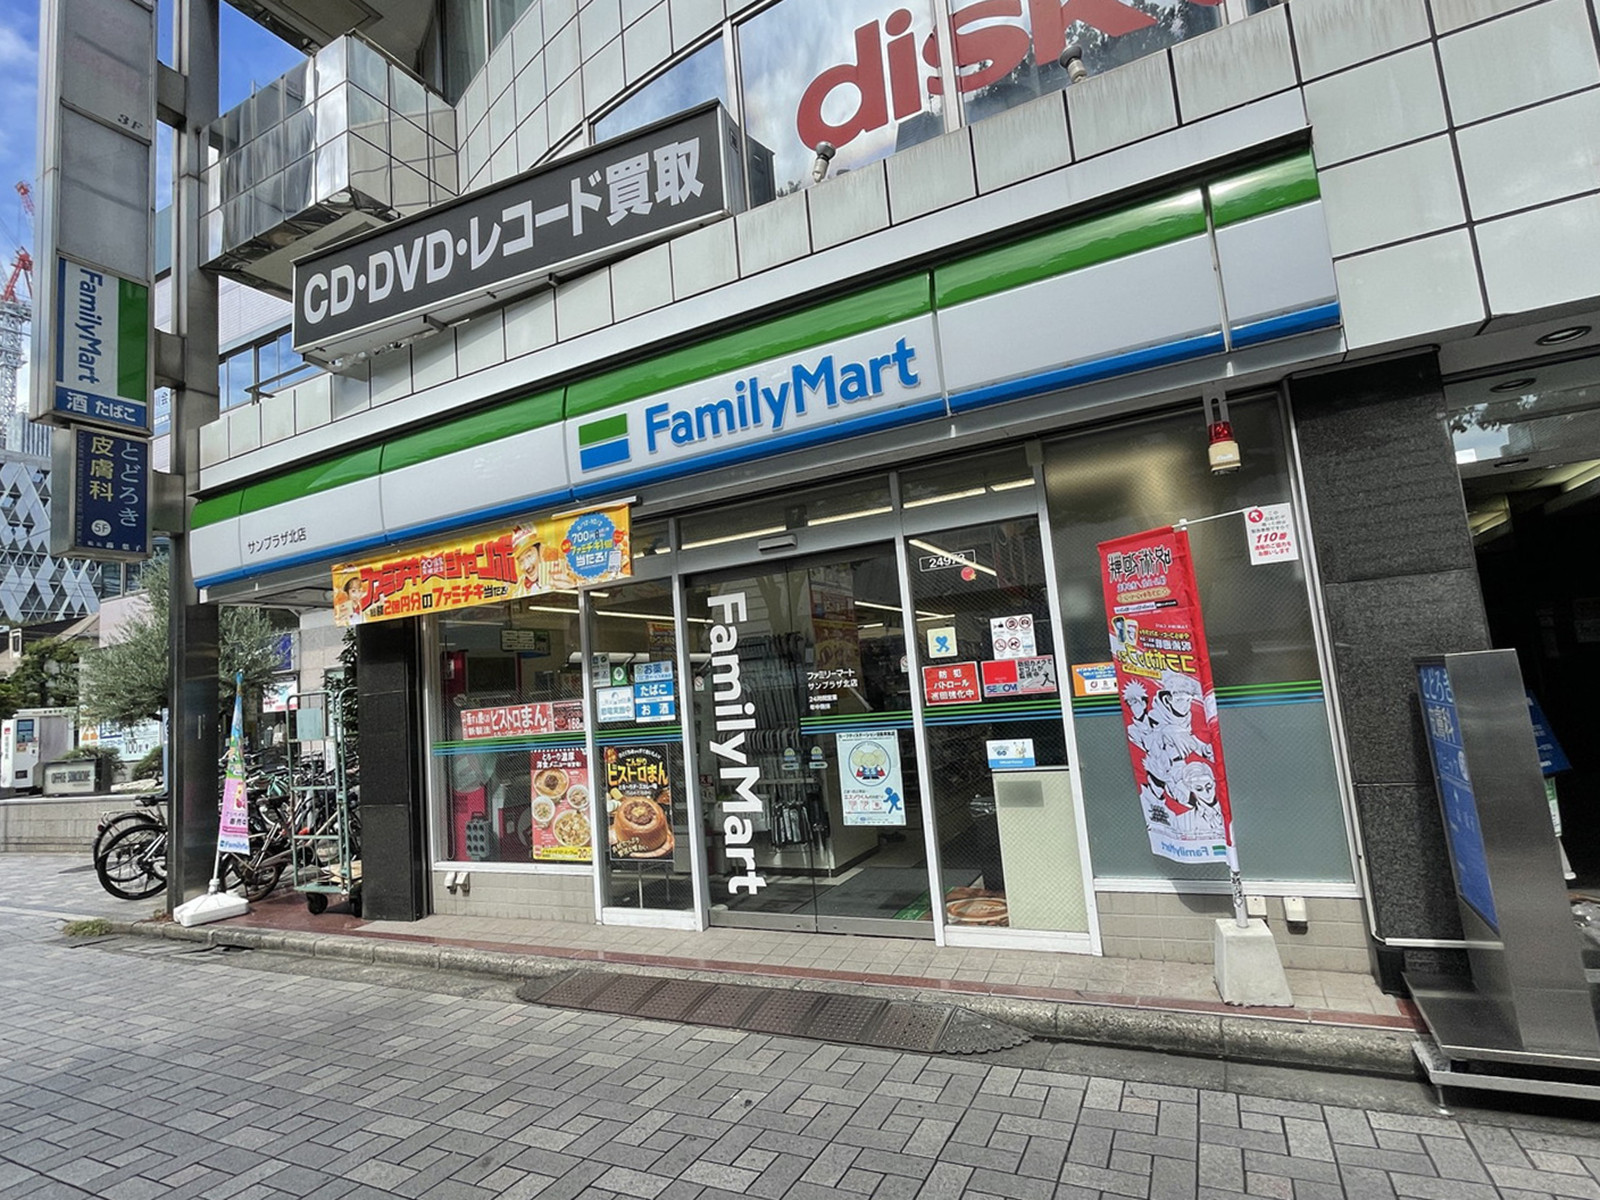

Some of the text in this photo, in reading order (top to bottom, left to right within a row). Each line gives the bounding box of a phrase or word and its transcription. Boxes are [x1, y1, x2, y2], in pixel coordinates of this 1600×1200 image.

[796, 0, 1222, 149] disk
[117, 114, 143, 130] 3F
[75, 268, 103, 384] FamilyMart
[67, 392, 136, 422] 酒 たばこ
[645, 337, 921, 453] FamilyMart
[90, 436, 114, 502] 皮膚科
[118, 442, 140, 527] とどろき
[248, 527, 306, 554] サンプラザ北店
[807, 668, 856, 680] ファミリーマート
[934, 681, 970, 690] パトロール
[640, 684, 668, 697] たばこ
[707, 591, 768, 895] FamilyMart
[607, 761, 670, 787] ビストロまん
